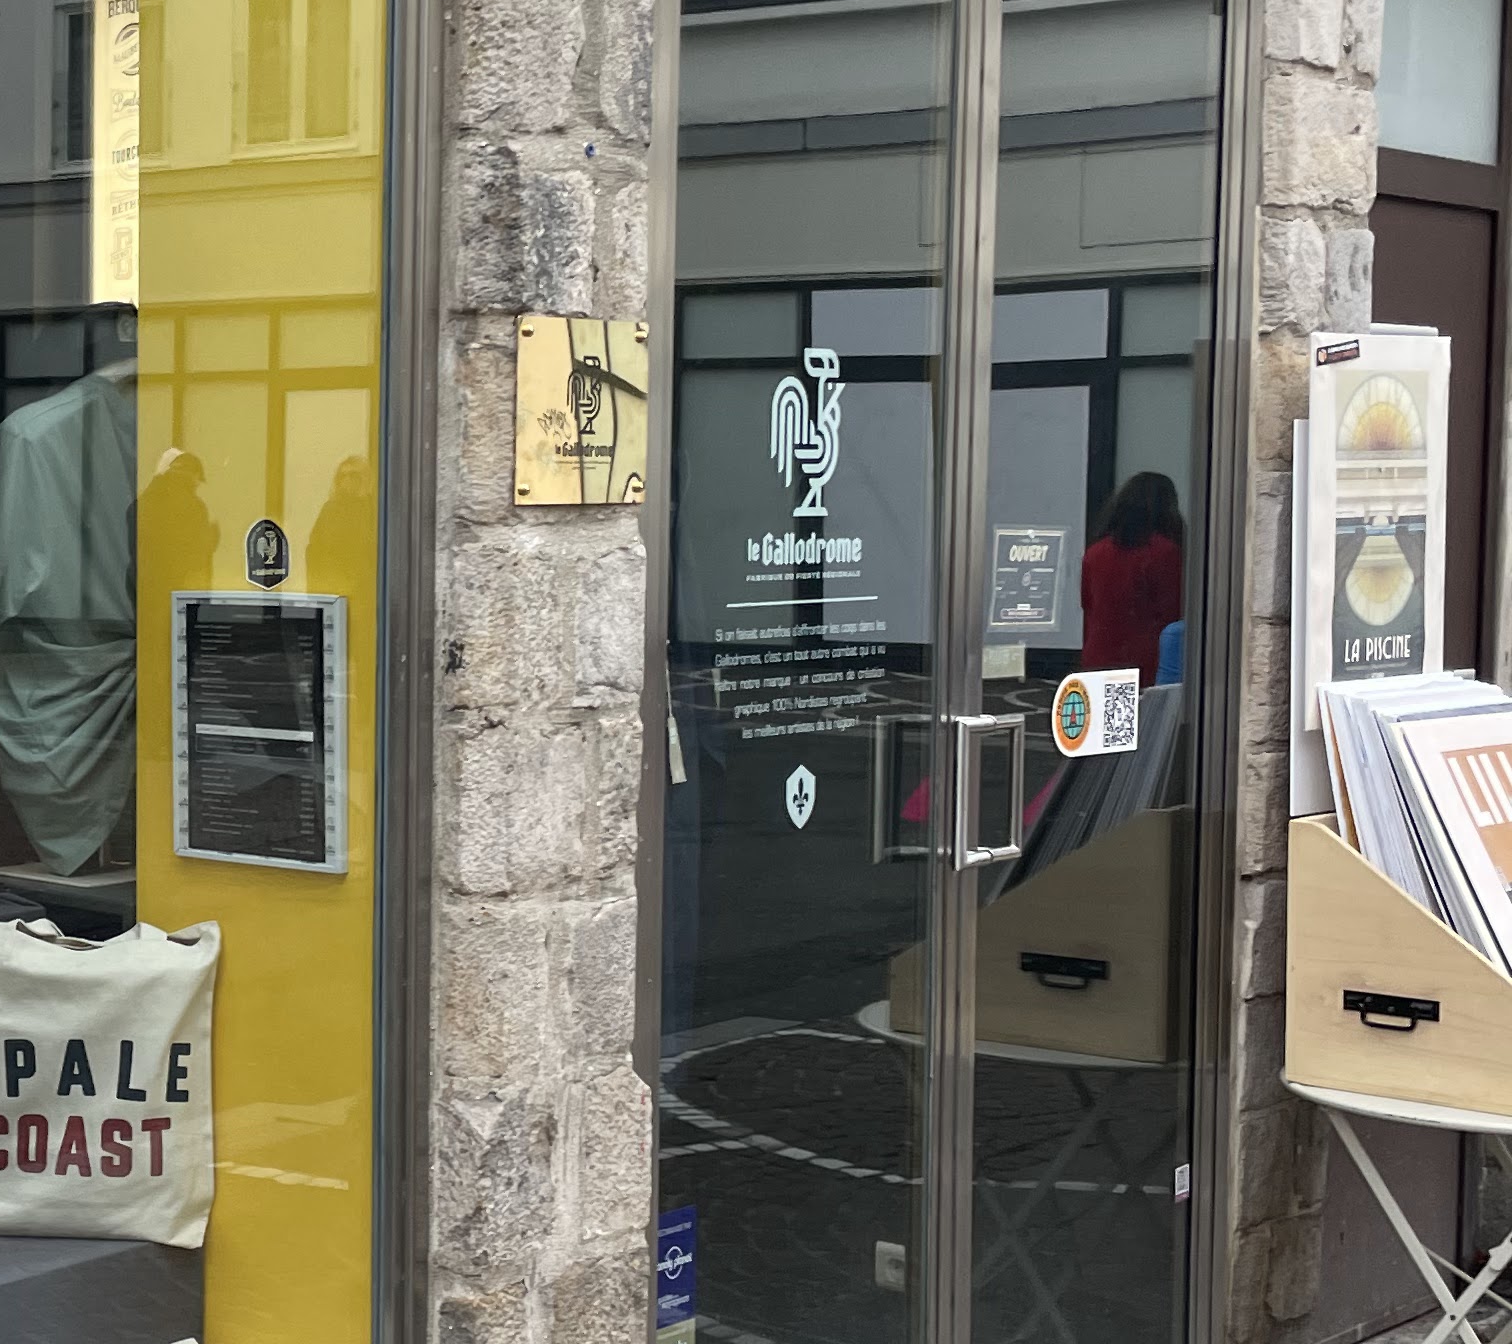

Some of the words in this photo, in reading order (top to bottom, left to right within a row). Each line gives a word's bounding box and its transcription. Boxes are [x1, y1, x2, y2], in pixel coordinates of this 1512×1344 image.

[747, 538, 761, 561] le
[762, 532, 863, 566] Gallodrome
[1009, 545, 1049, 562] OUVERT
[1343, 636, 1362, 666] LA
[1365, 632, 1412, 663] PISCINE
